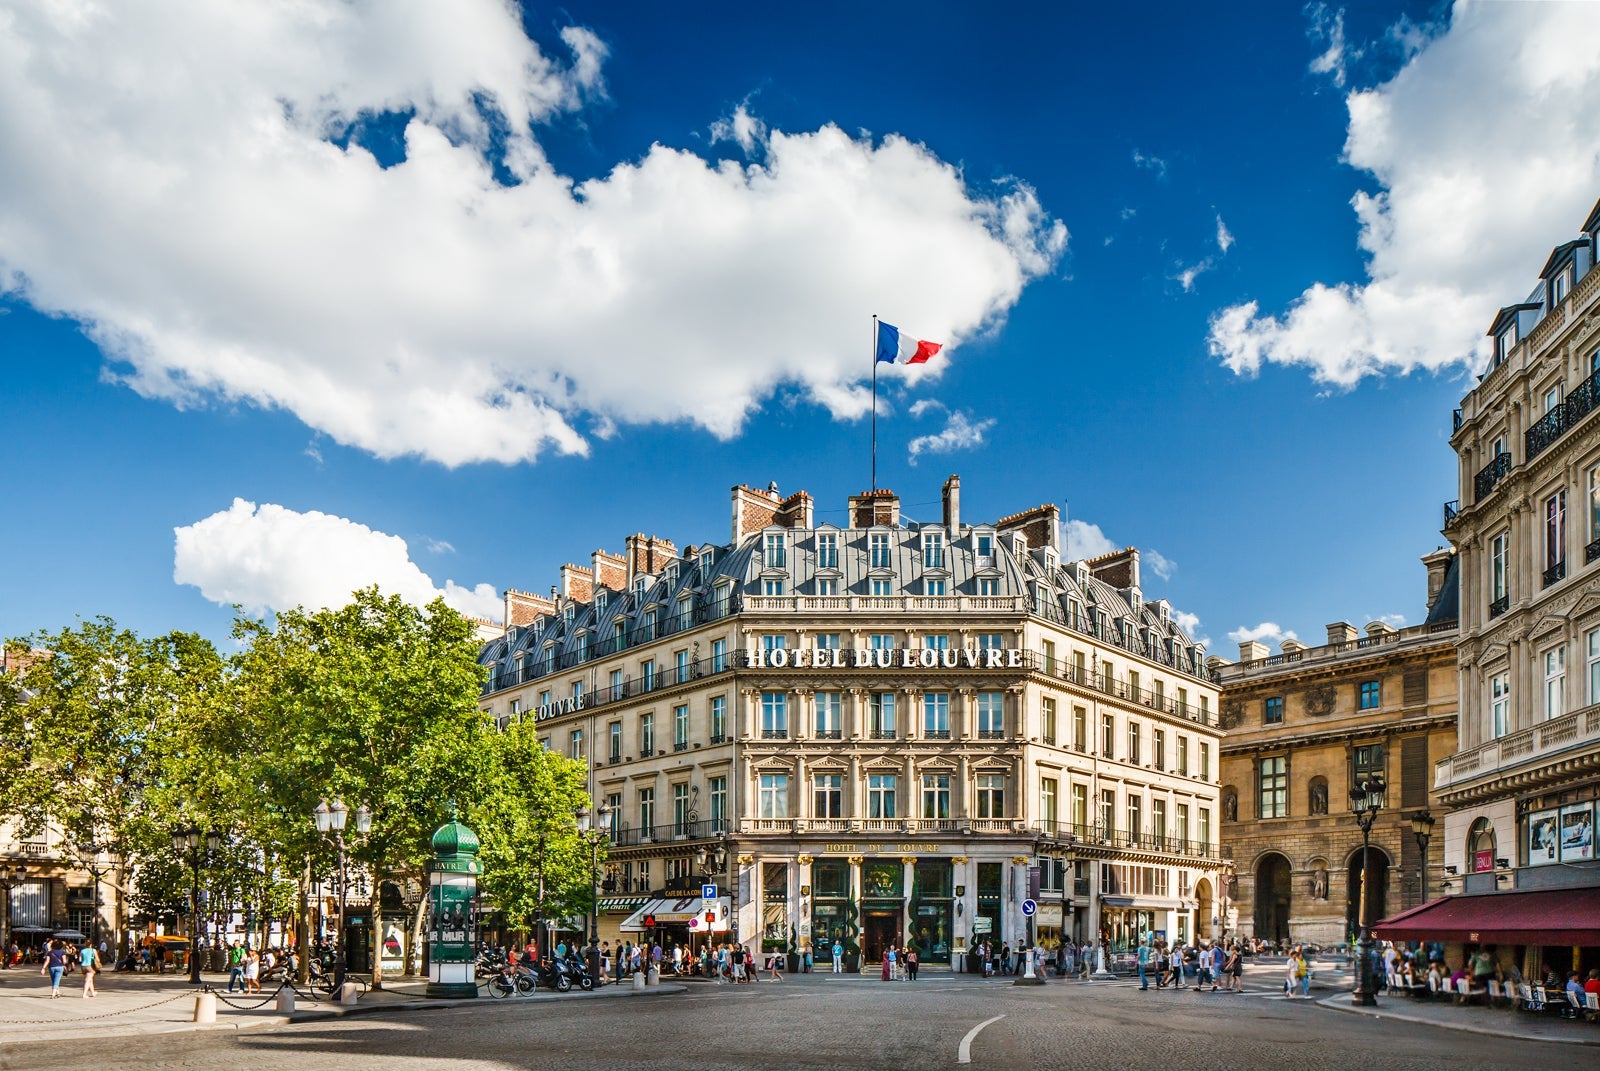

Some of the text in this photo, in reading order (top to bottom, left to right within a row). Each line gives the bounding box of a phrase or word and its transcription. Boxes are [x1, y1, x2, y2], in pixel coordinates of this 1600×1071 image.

[746, 648, 1024, 668] HOTEL DU LOUVRE
[826, 844, 940, 852] HOTEL DU LOUVRE
[706, 888, 713, 897] P
